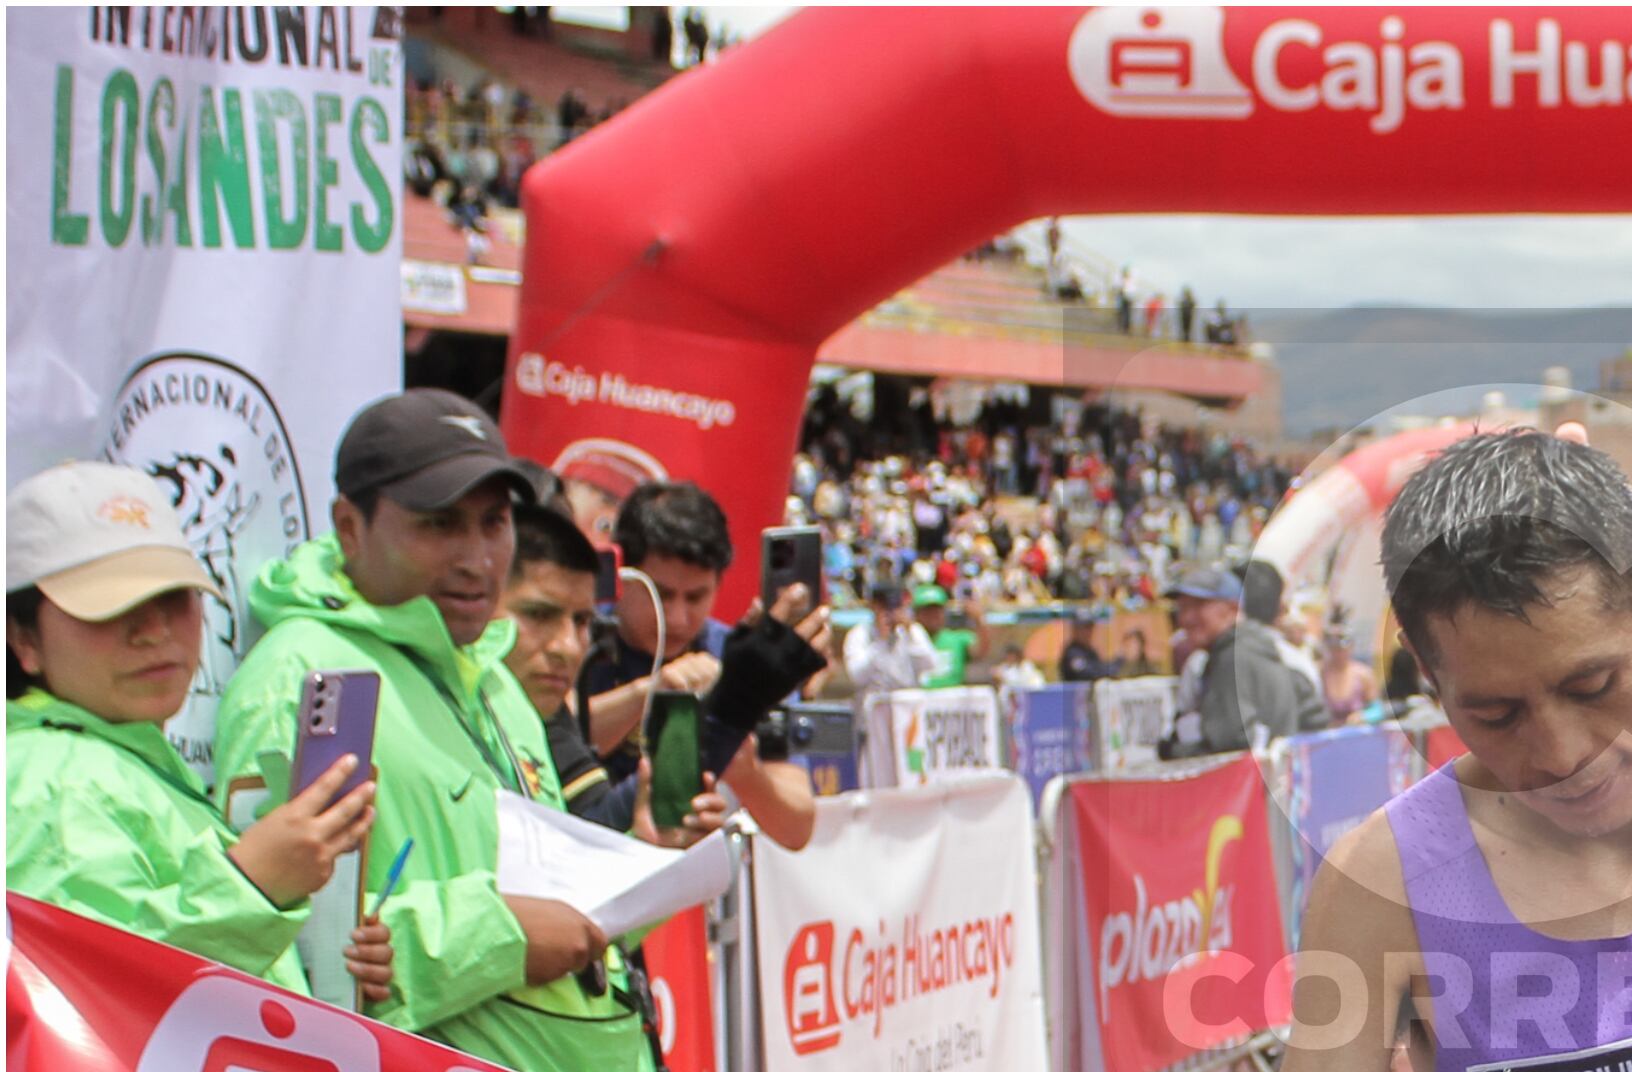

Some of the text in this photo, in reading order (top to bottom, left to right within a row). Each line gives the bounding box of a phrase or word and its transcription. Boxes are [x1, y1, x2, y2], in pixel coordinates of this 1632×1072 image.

[1252, 17, 1464, 134] Caja
[52, 65, 395, 254] LOS ANDES
[104, 373, 263, 464] ERNACIONAL
[843, 911, 1015, 1040] Caja Huancayo
